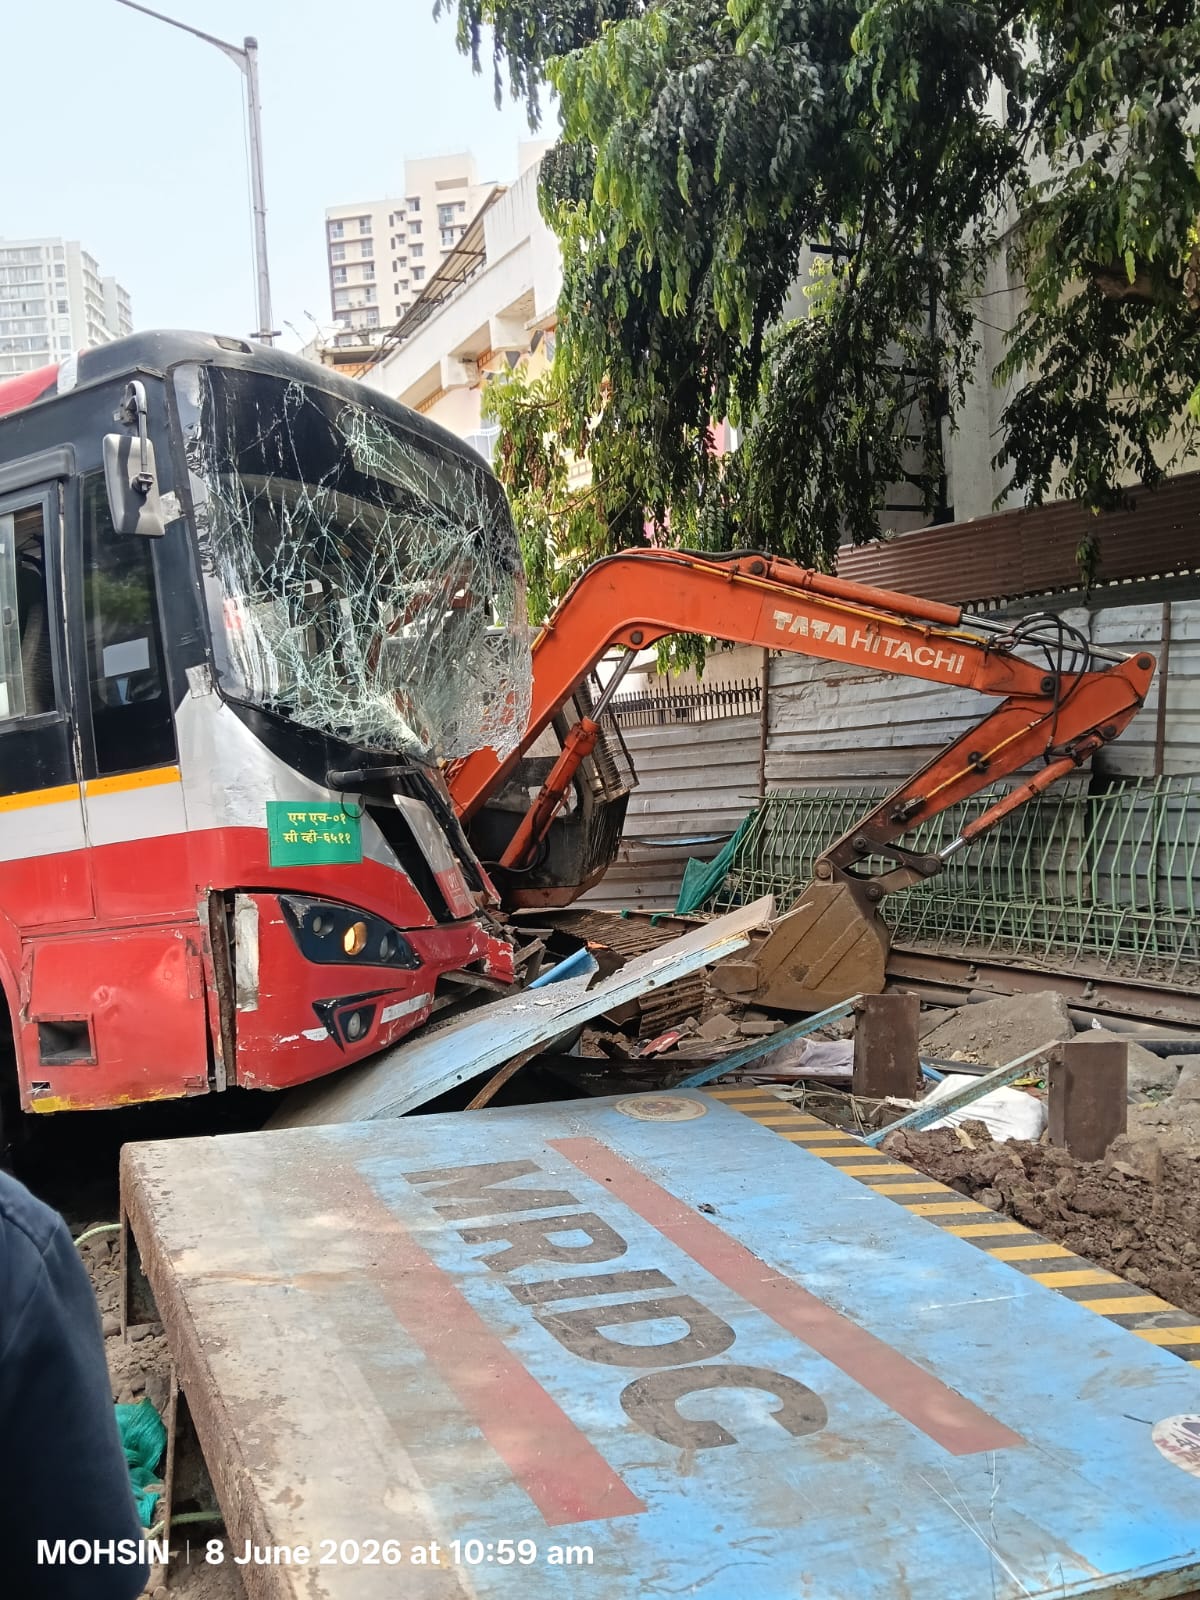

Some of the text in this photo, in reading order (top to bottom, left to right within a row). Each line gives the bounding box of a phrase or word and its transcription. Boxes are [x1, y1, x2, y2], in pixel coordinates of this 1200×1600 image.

[773, 610, 965, 674] TATA HITACHI
[283, 829, 299, 843] सी
[287, 812, 346, 826] एम एच-०१
[402, 1159, 828, 1450] MRIDC
